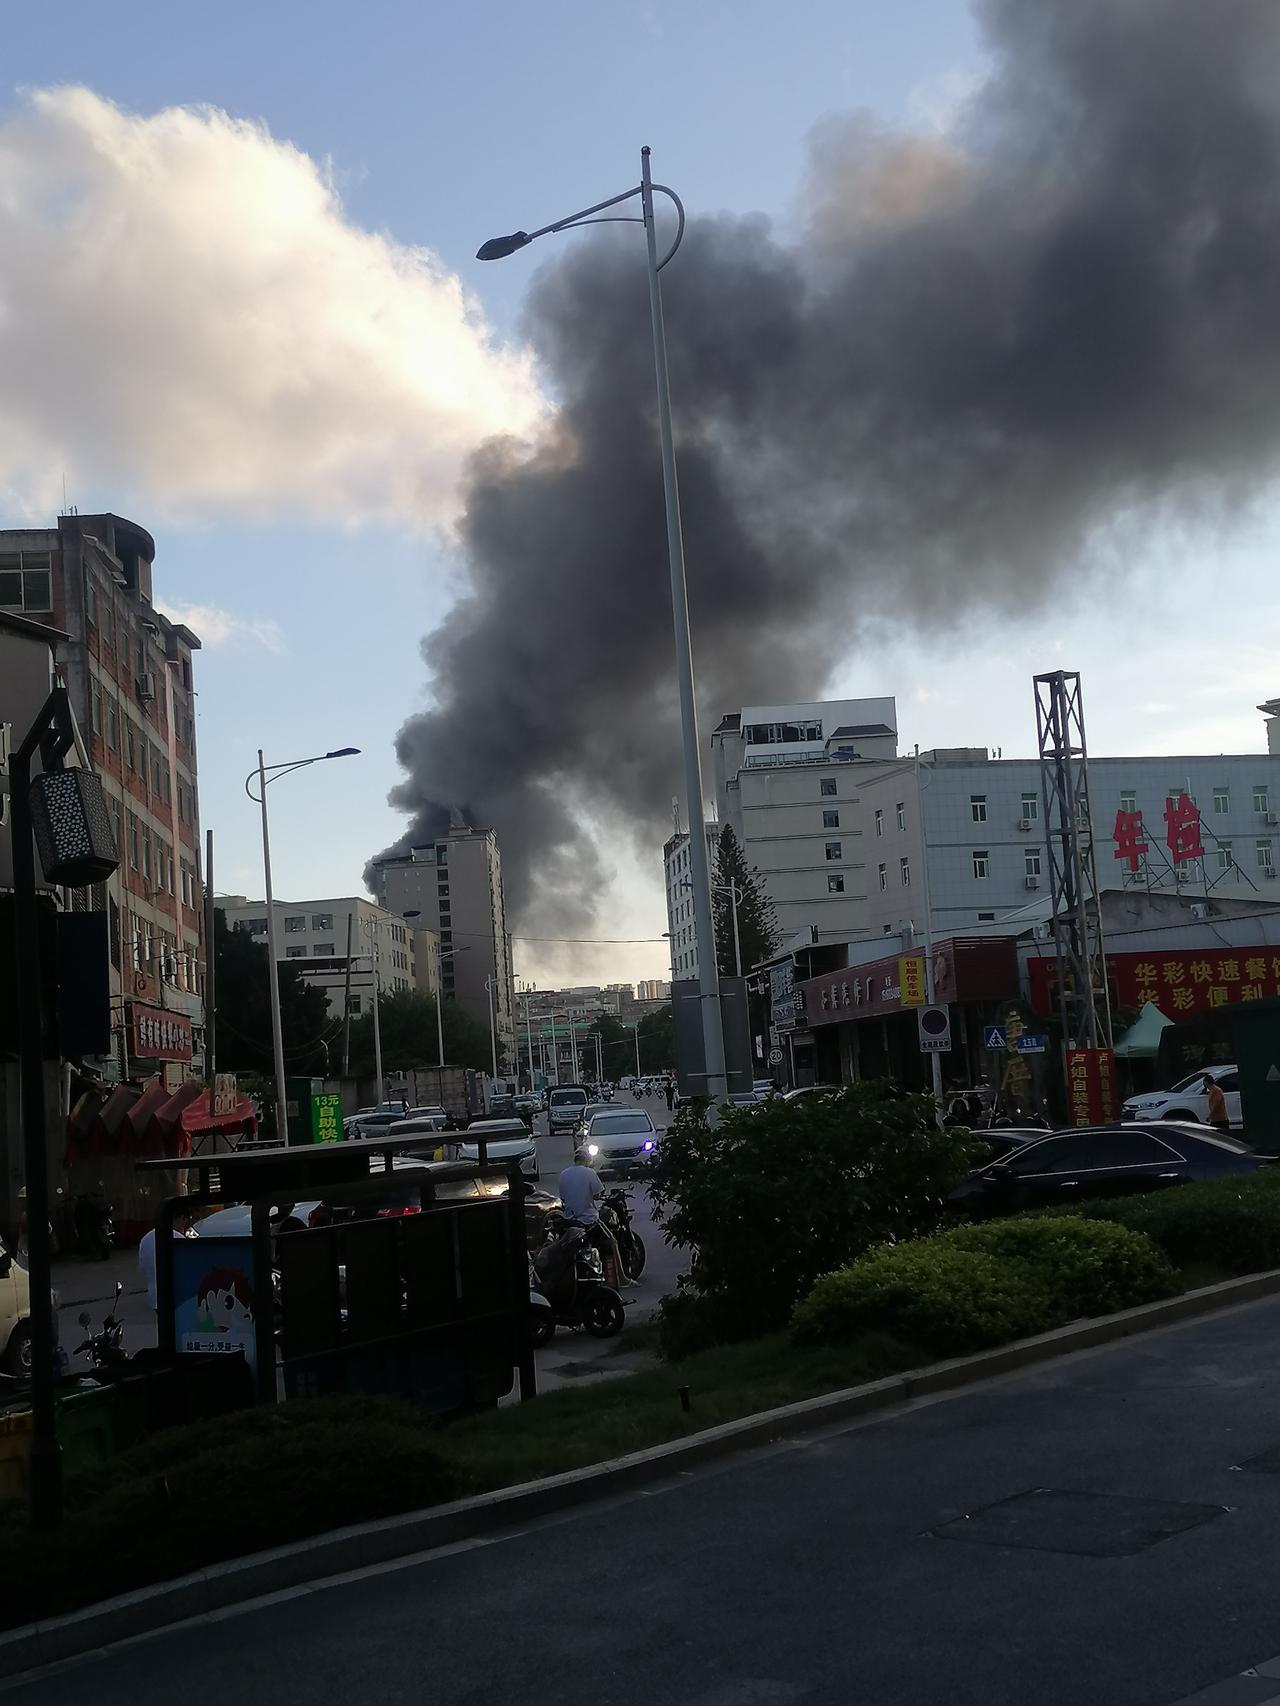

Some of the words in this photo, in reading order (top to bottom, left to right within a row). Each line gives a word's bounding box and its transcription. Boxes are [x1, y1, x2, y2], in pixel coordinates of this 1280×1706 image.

[1137, 984, 1280, 1010] 华彩便利
[771, 1050, 781, 1061] 20
[315, 1094, 339, 1106] 13元
